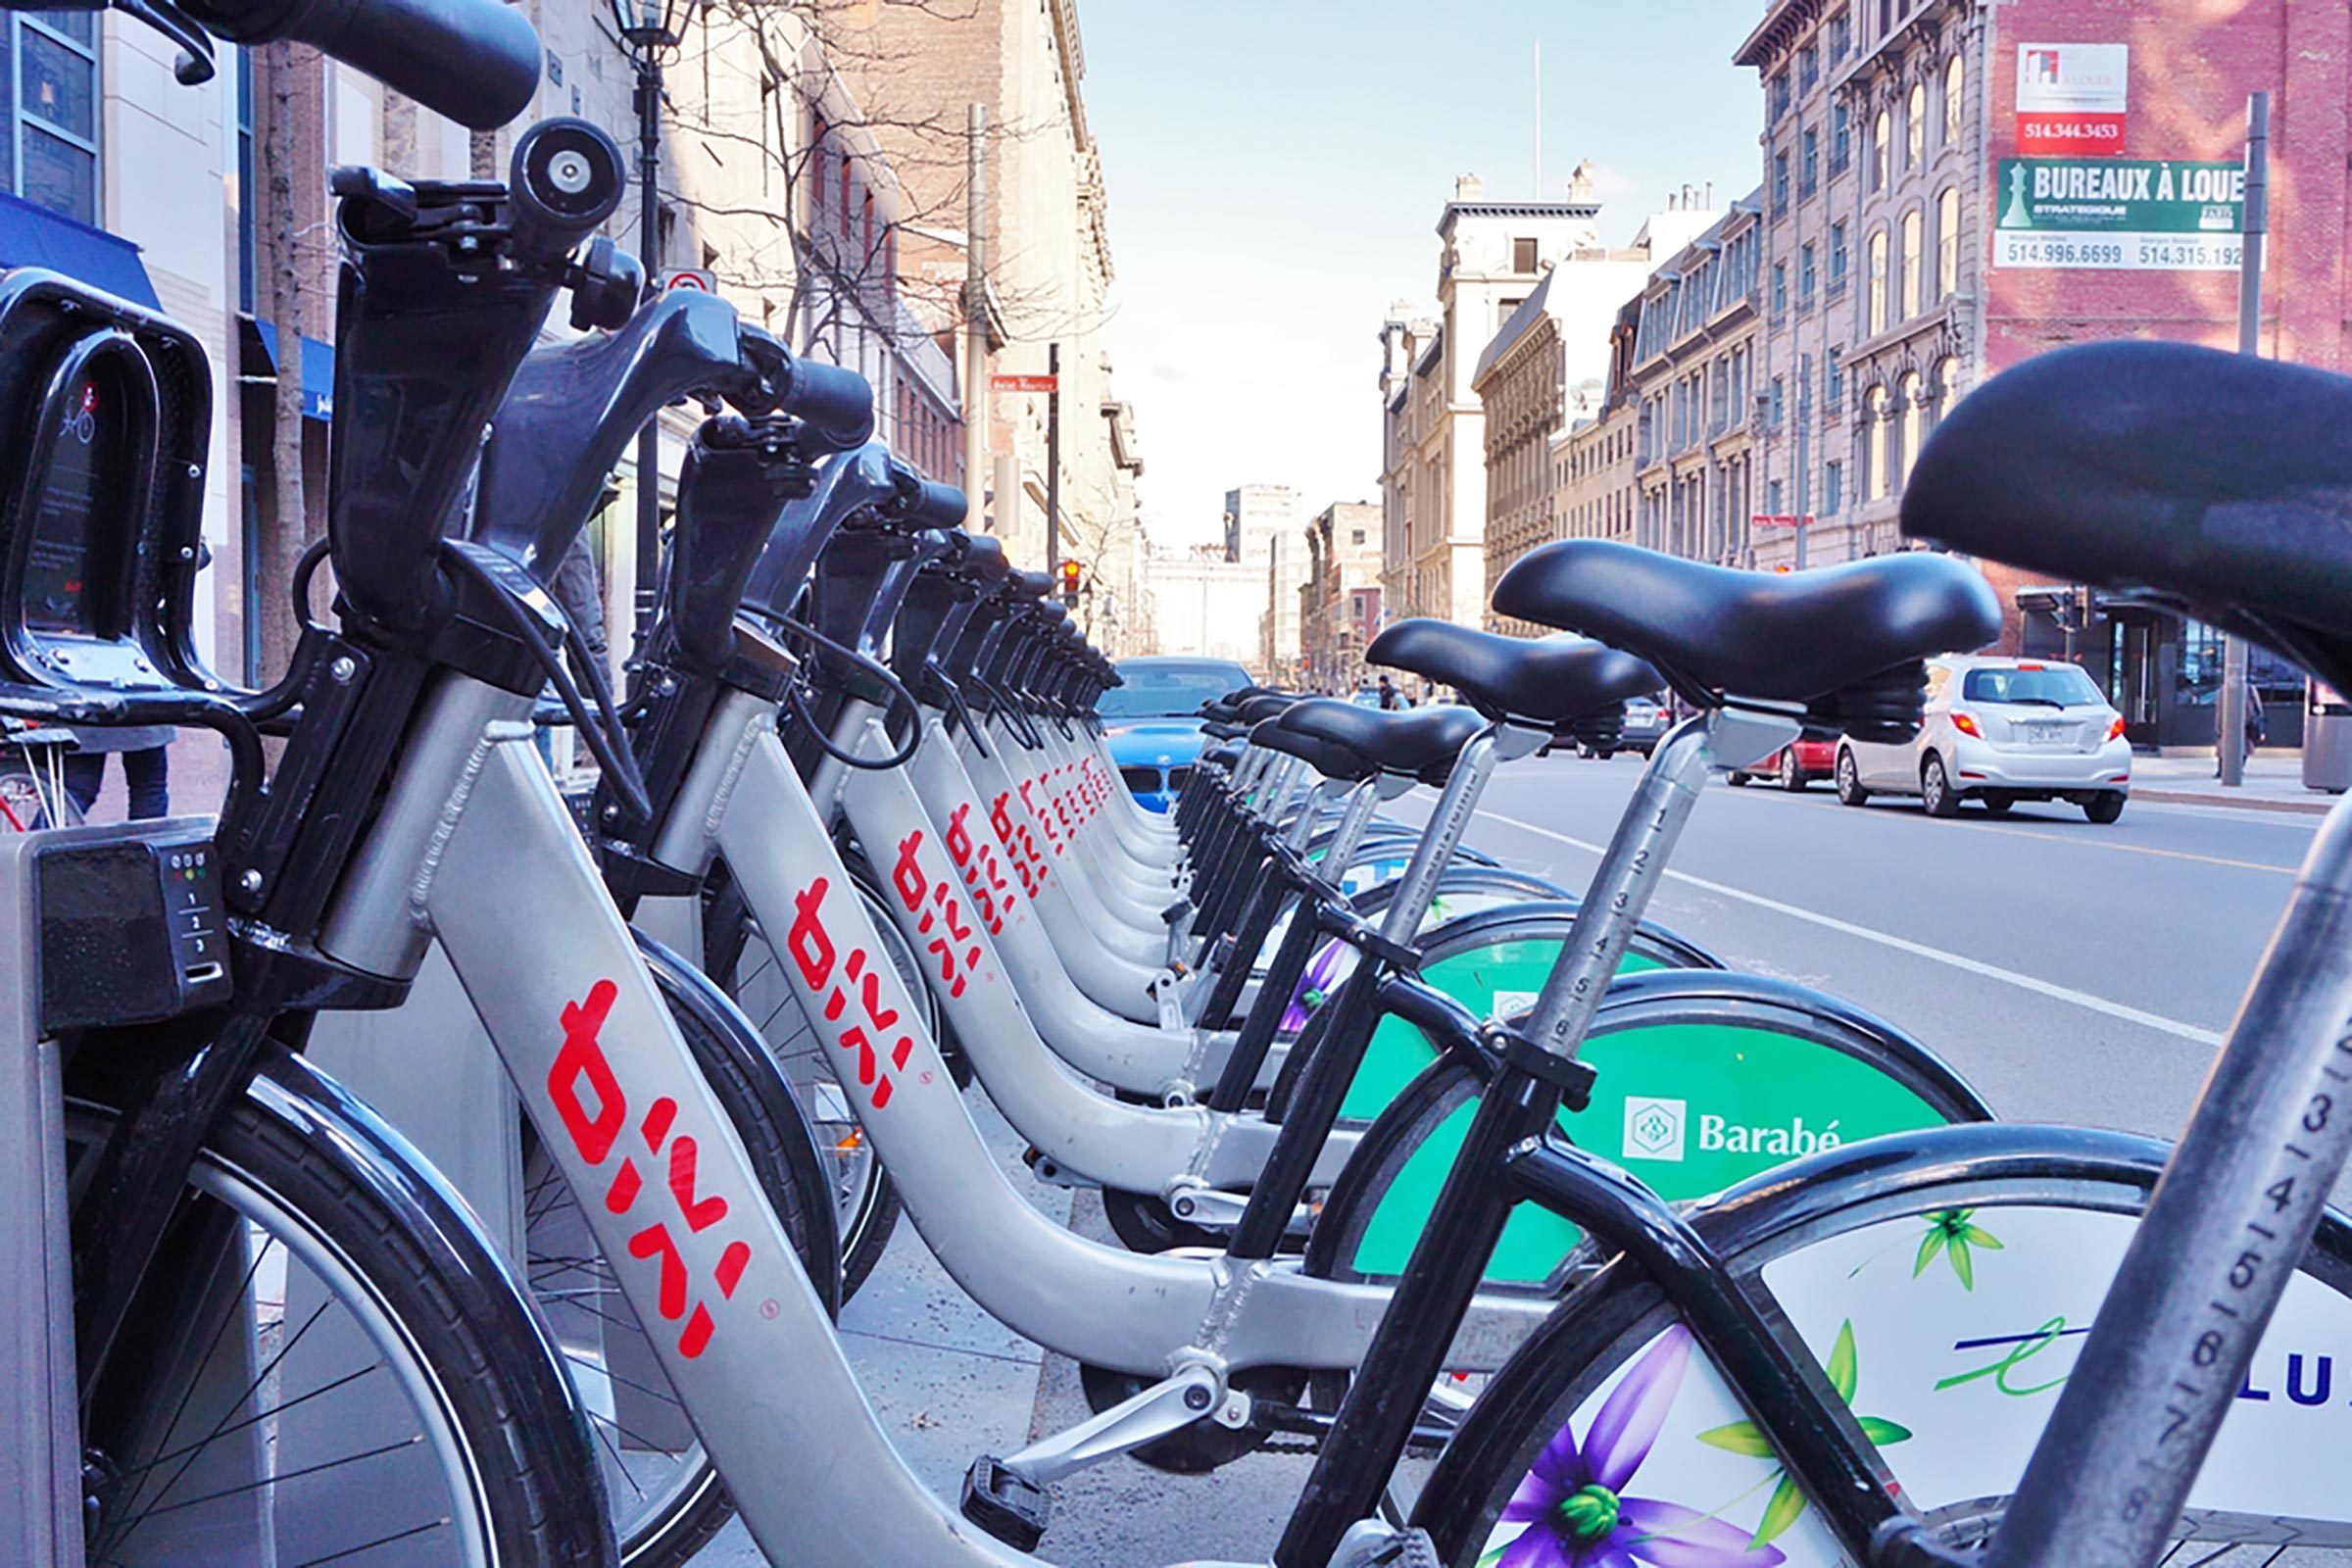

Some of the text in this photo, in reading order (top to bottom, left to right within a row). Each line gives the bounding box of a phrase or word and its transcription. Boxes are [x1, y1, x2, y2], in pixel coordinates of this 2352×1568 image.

[2034, 162, 2245, 202] BUREAUX À LOUE
[2008, 243, 2122, 264] 514.996.6699
[2138, 246, 2243, 266] 514.315.192
[1655, 808, 1666, 825] 1
[1635, 851, 1649, 868] 2
[1613, 892, 1629, 907] 3
[191, 915, 200, 929] 2
[1594, 937, 1608, 952] 4
[1574, 978, 1590, 994] 5
[1555, 1021, 1568, 1036] 6
[2304, 1094, 2334, 1134] 3
[1698, 1114, 1841, 1156] Barabé
[2265, 1176, 2294, 1212] 4
[2230, 1254, 2261, 1290] 5
[2158, 1405, 2190, 1446] 7
